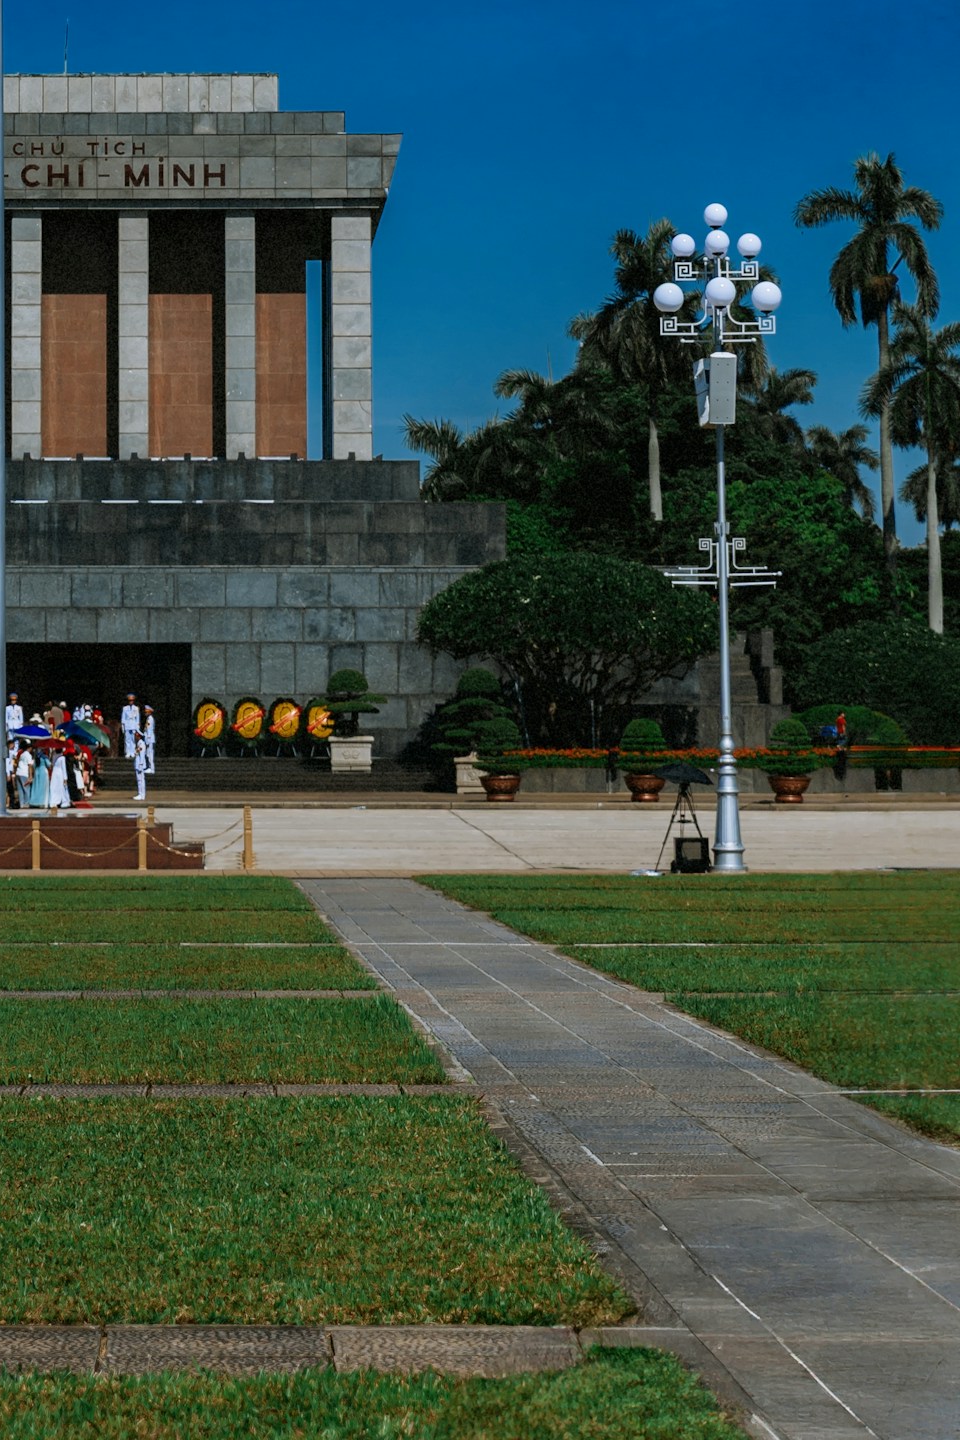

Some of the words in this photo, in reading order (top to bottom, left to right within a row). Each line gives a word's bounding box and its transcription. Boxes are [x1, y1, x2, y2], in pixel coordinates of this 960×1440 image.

[12, 136, 65, 156] CHỦ
[86, 137, 145, 161] TỊCH
[20, 158, 87, 188] CHÍ
[124, 156, 226, 188] MINH
